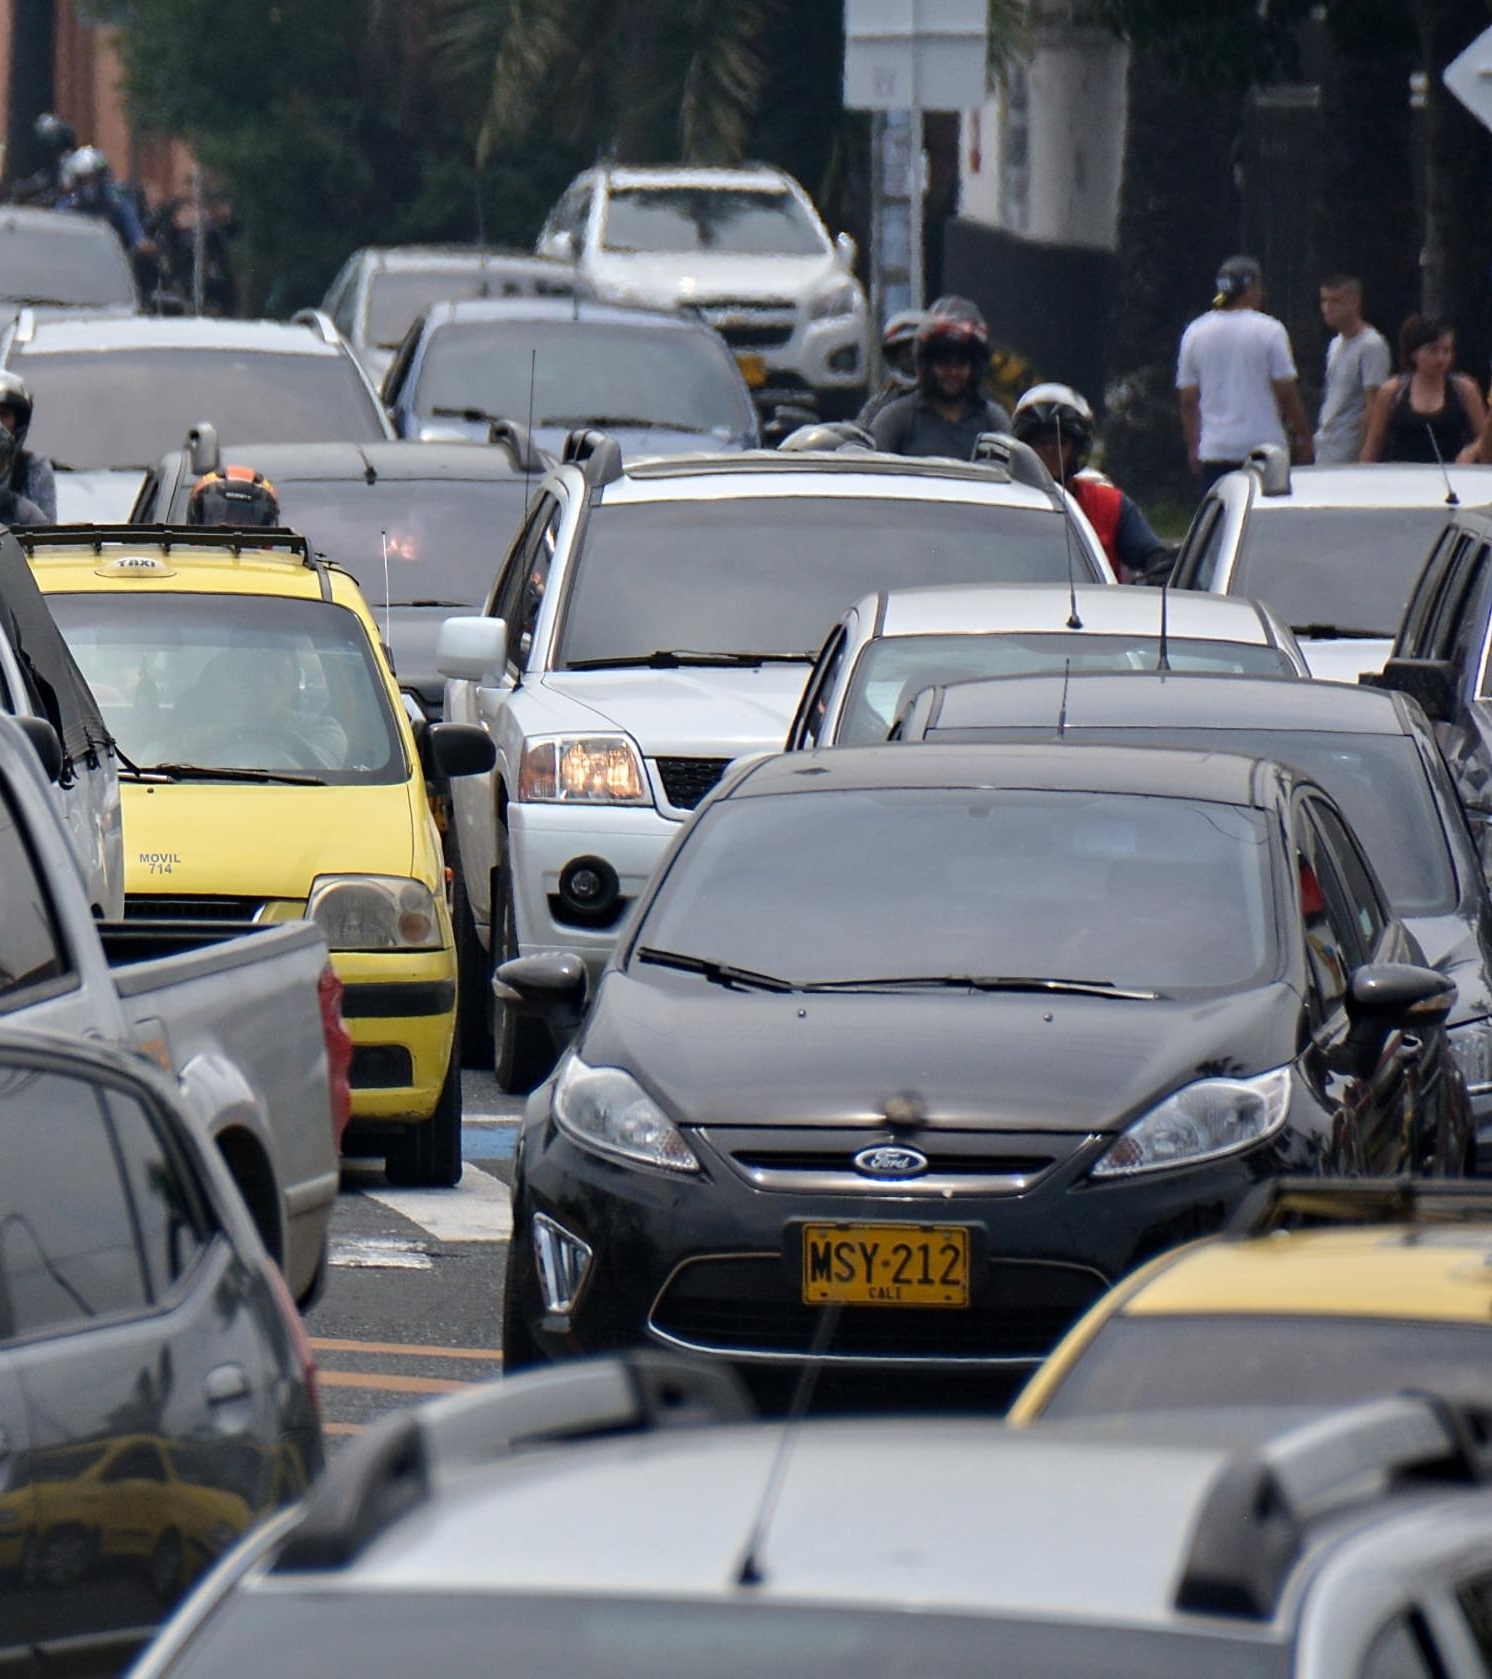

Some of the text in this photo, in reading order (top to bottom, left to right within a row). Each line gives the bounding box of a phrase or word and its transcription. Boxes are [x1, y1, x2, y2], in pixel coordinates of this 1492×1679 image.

[117, 559, 156, 569] TAXI
[139, 853, 181, 863] MOVIL
[149, 864, 172, 874] 714
[870, 1150, 909, 1169] Ford
[868, 1286, 901, 1301] CALI
